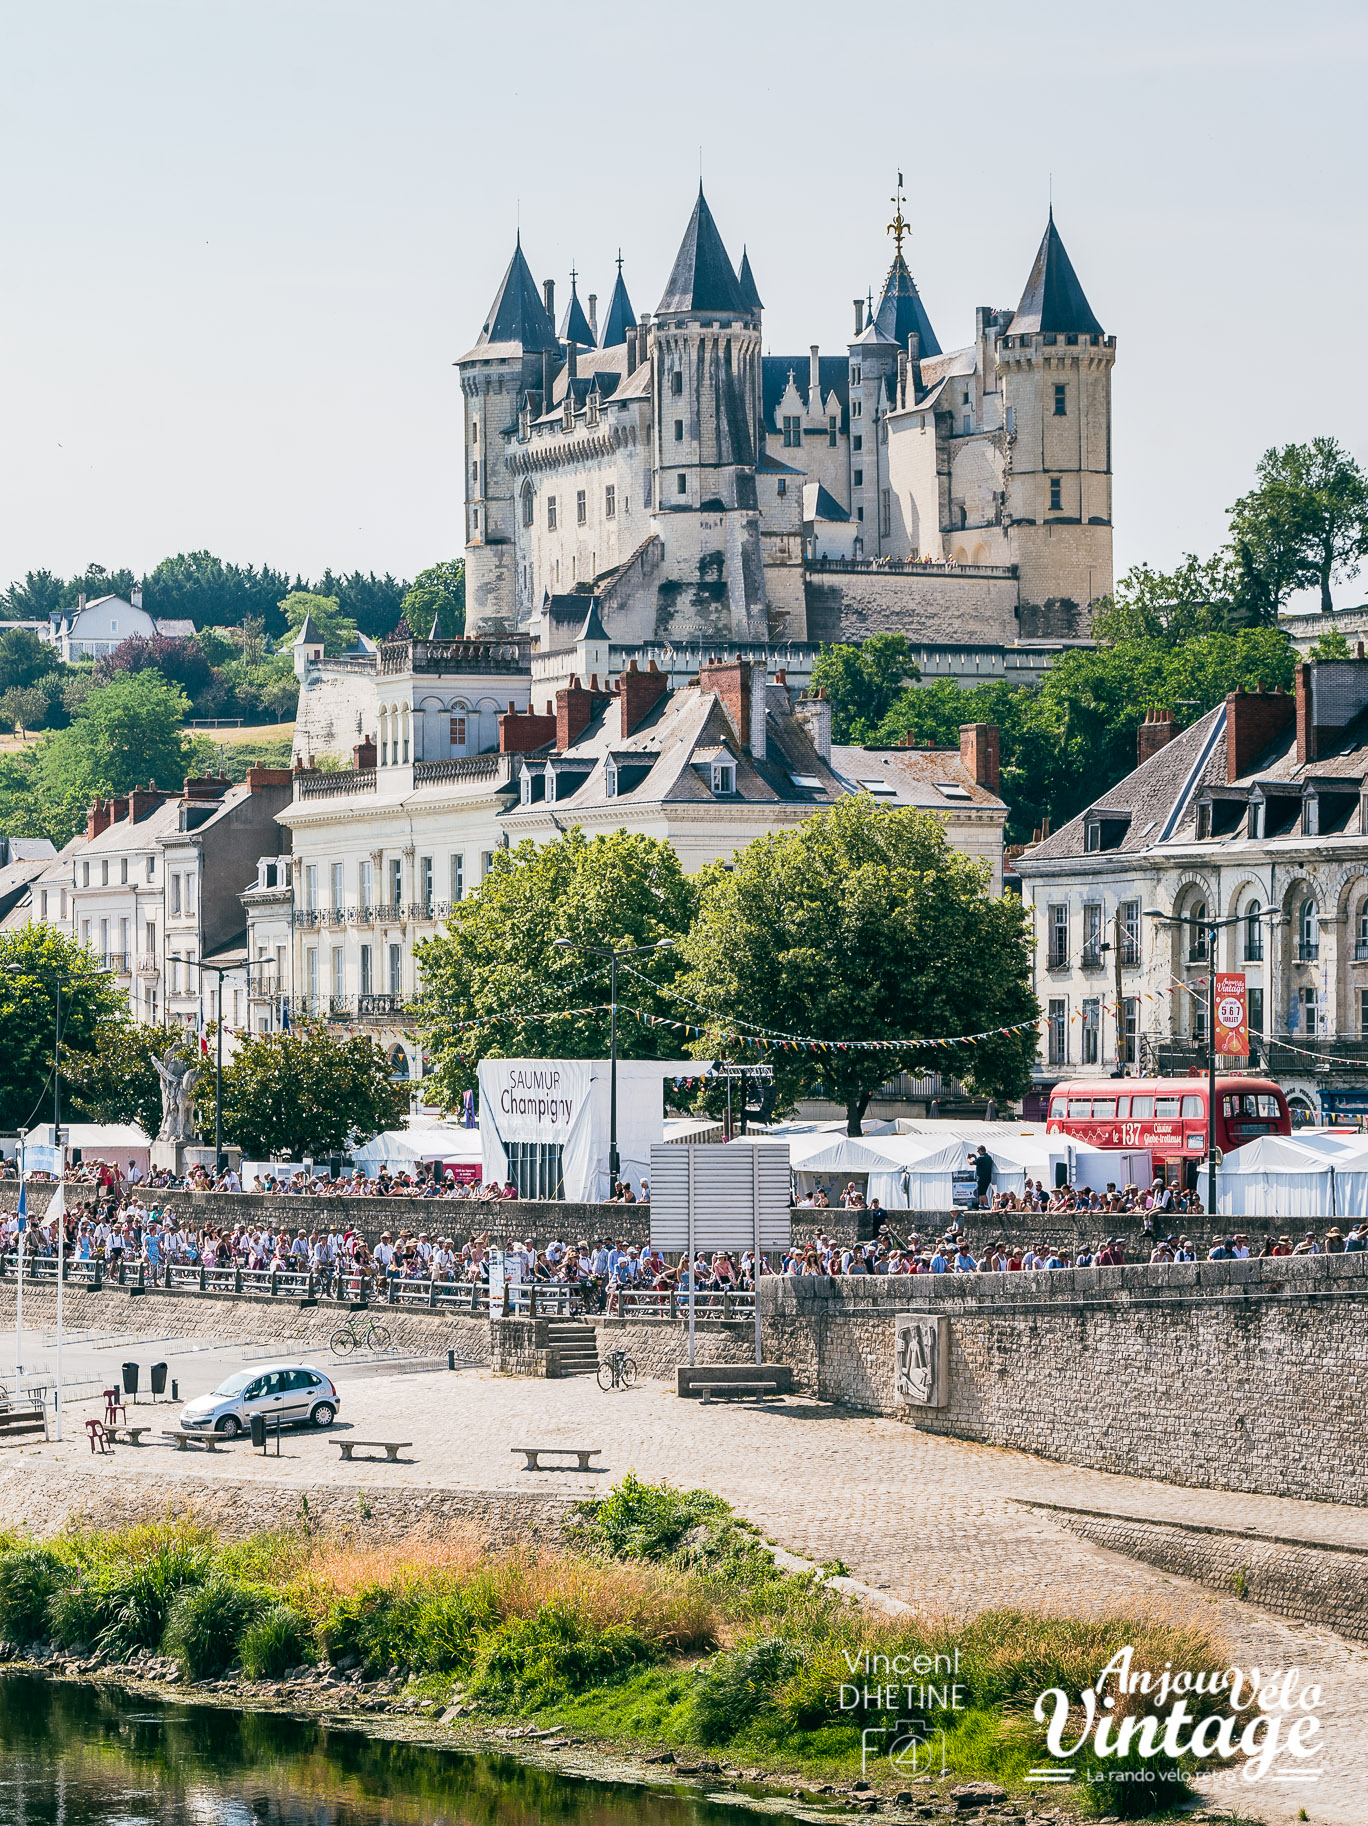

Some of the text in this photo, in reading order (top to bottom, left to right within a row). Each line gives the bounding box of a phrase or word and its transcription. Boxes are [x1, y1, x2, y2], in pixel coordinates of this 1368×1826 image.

[1217, 982, 1245, 996] Vintage
[1222, 1006, 1240, 1016] 5 6 7
[509, 1070, 561, 1090] SAUMUR
[500, 1088, 573, 1126] Champigny
[1121, 1122, 1142, 1146] 137
[1153, 1122, 1173, 1134] Cuisine
